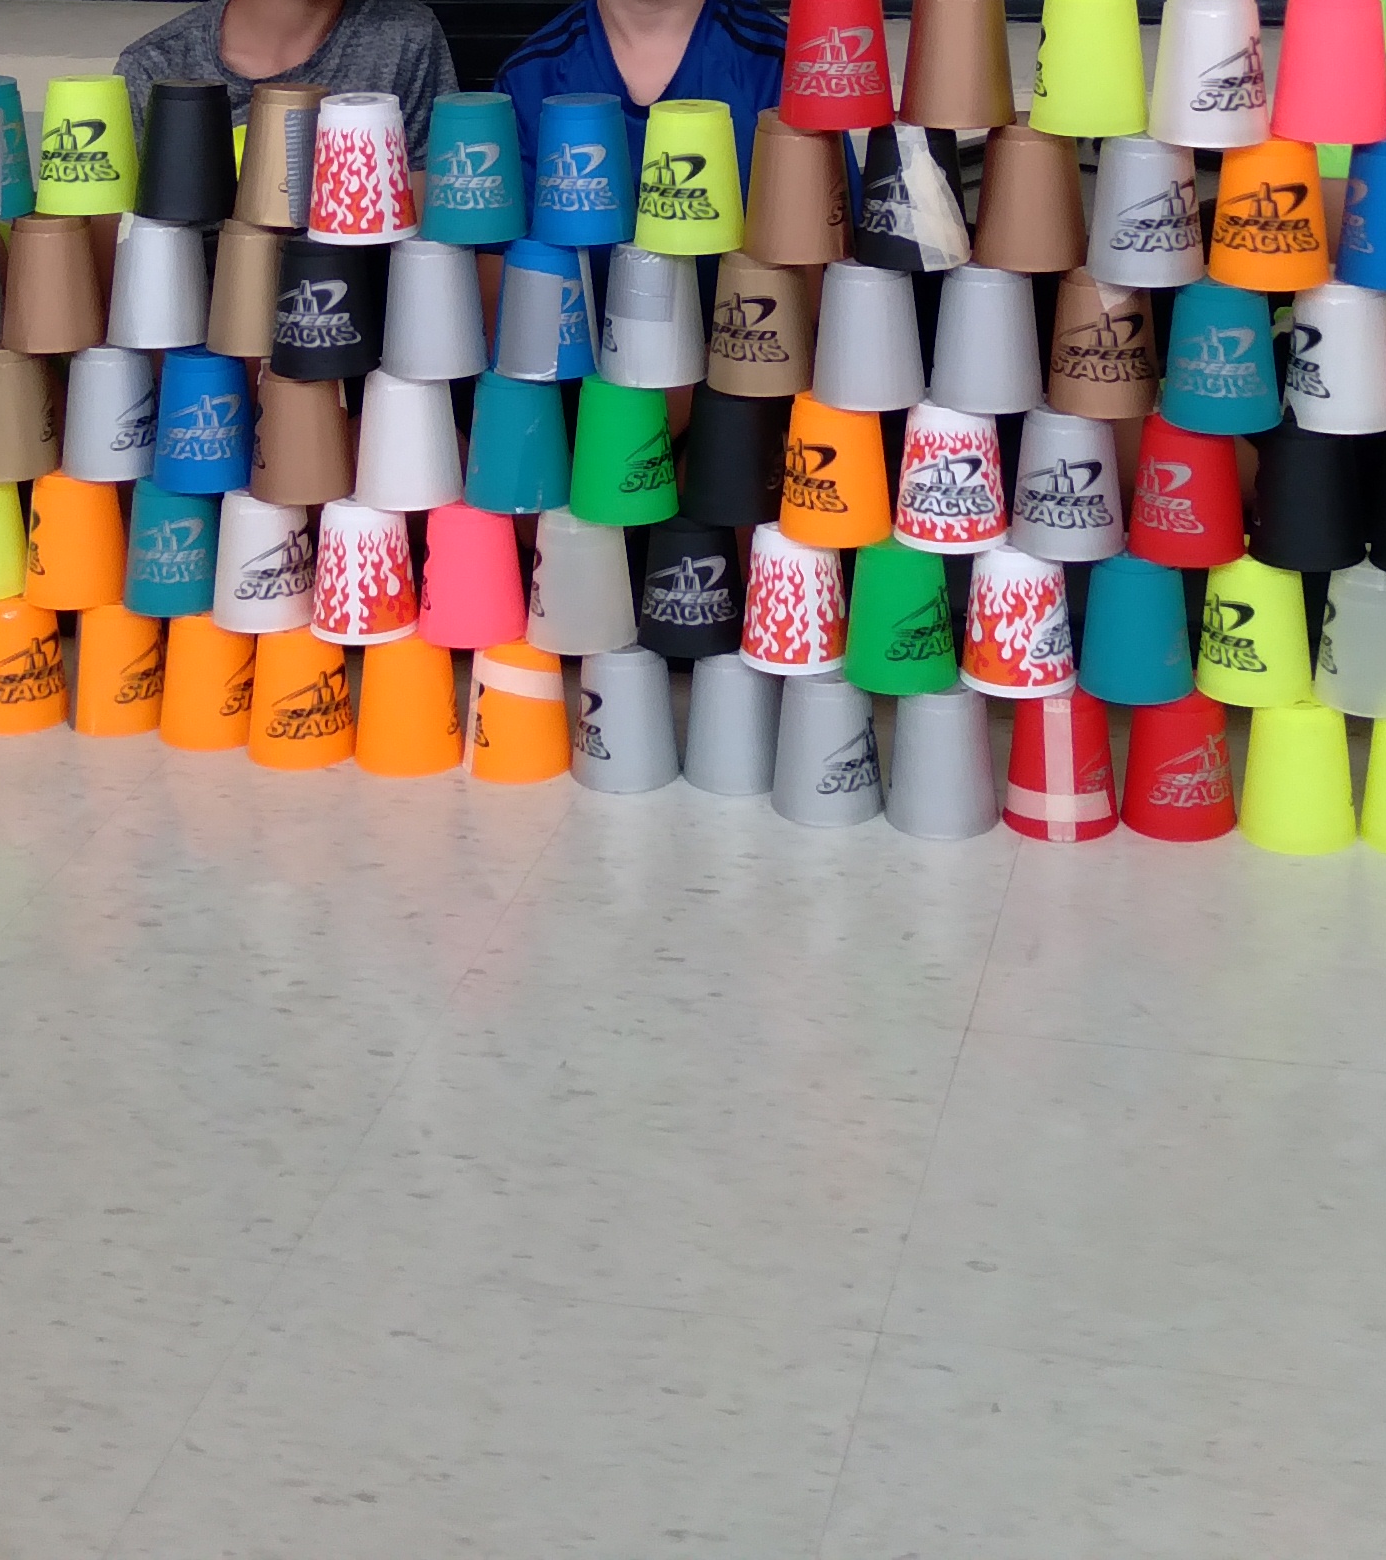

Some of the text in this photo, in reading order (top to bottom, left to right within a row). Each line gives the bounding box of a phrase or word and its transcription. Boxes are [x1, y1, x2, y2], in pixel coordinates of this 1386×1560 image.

[795, 61, 877, 75] SPEED
[1190, 84, 1265, 111] STAC
[1228, 216, 1309, 232] SPEED
[1065, 345, 1145, 362] SPEED
[916, 478, 986, 492] SPEED
[900, 489, 996, 516] STACKS
[1025, 490, 1103, 506] SPEED
[651, 589, 729, 603] SPEED
